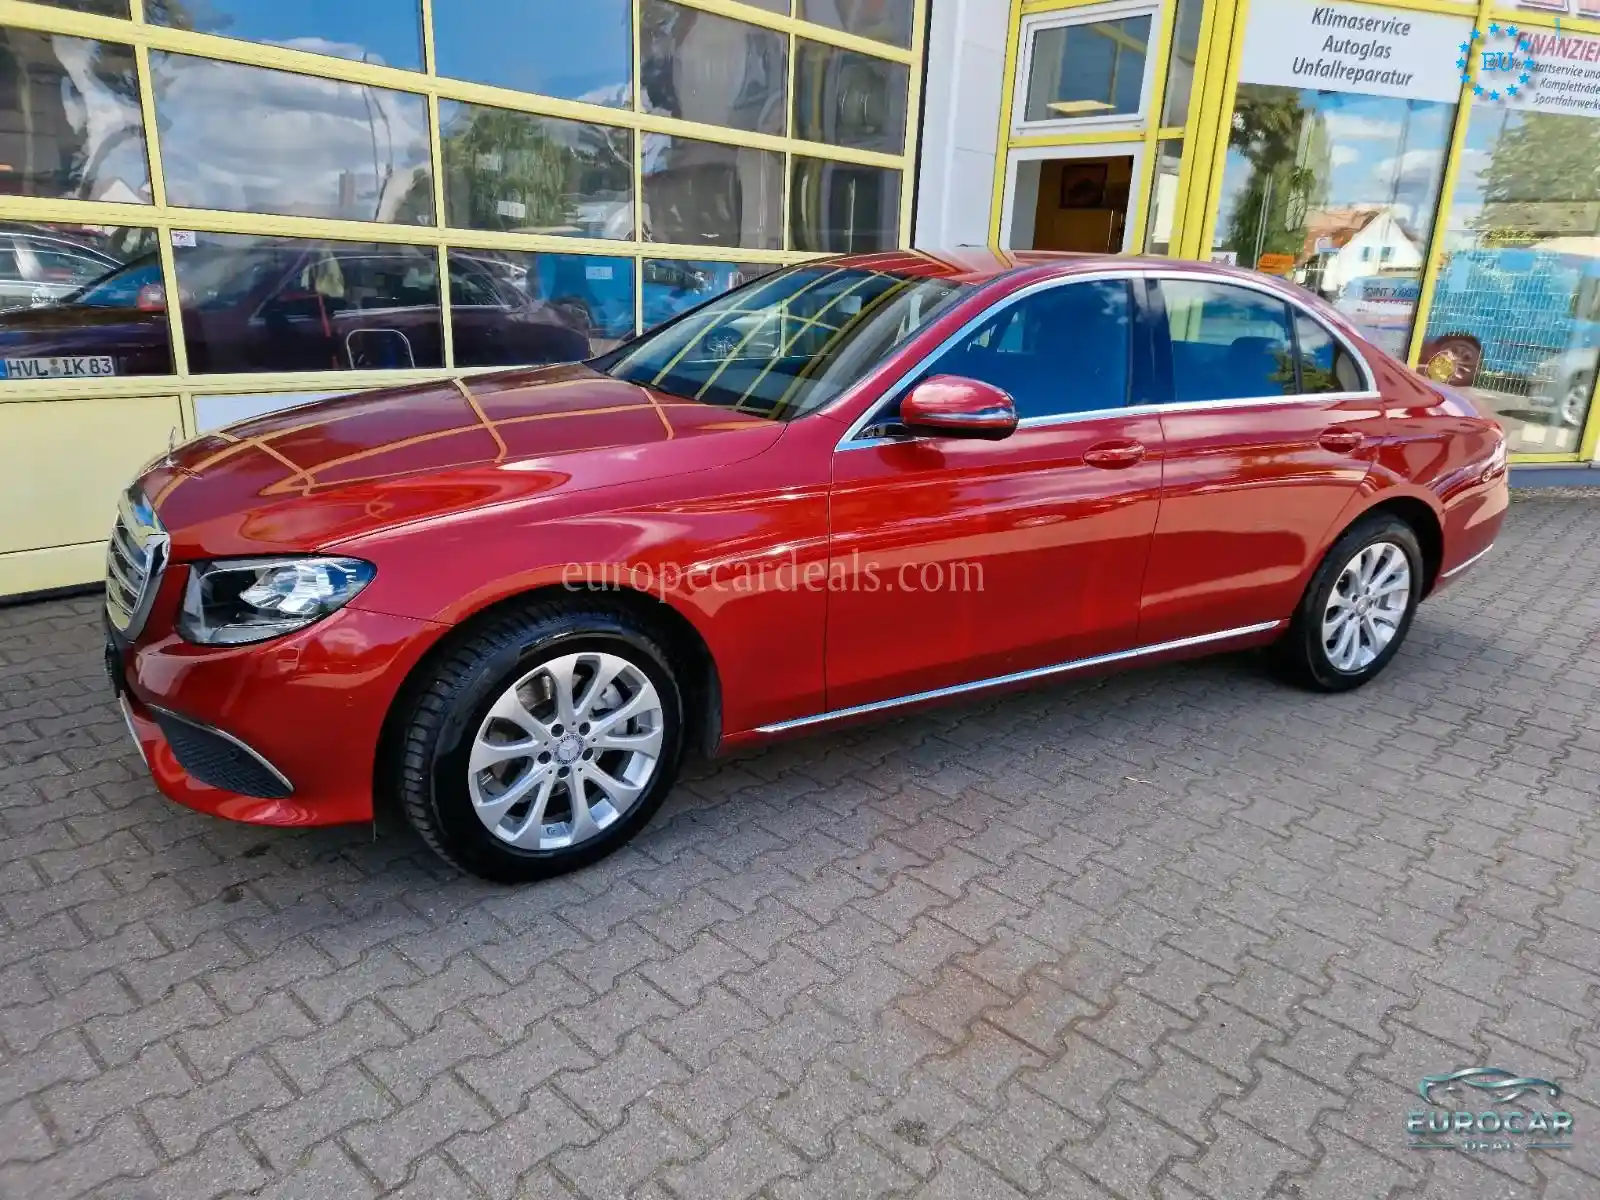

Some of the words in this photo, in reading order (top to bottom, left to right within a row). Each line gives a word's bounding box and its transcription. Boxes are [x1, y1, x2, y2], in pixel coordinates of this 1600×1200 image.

[1311, 7, 1411, 36] Klimaservice
[1321, 35, 1392, 60] Autoglas
[1513, 31, 1600, 62] FINANZIE
[1292, 56, 1414, 86] Unfallreparatur
[7, 359, 48, 377] HVL
[63, 358, 86, 376] IK
